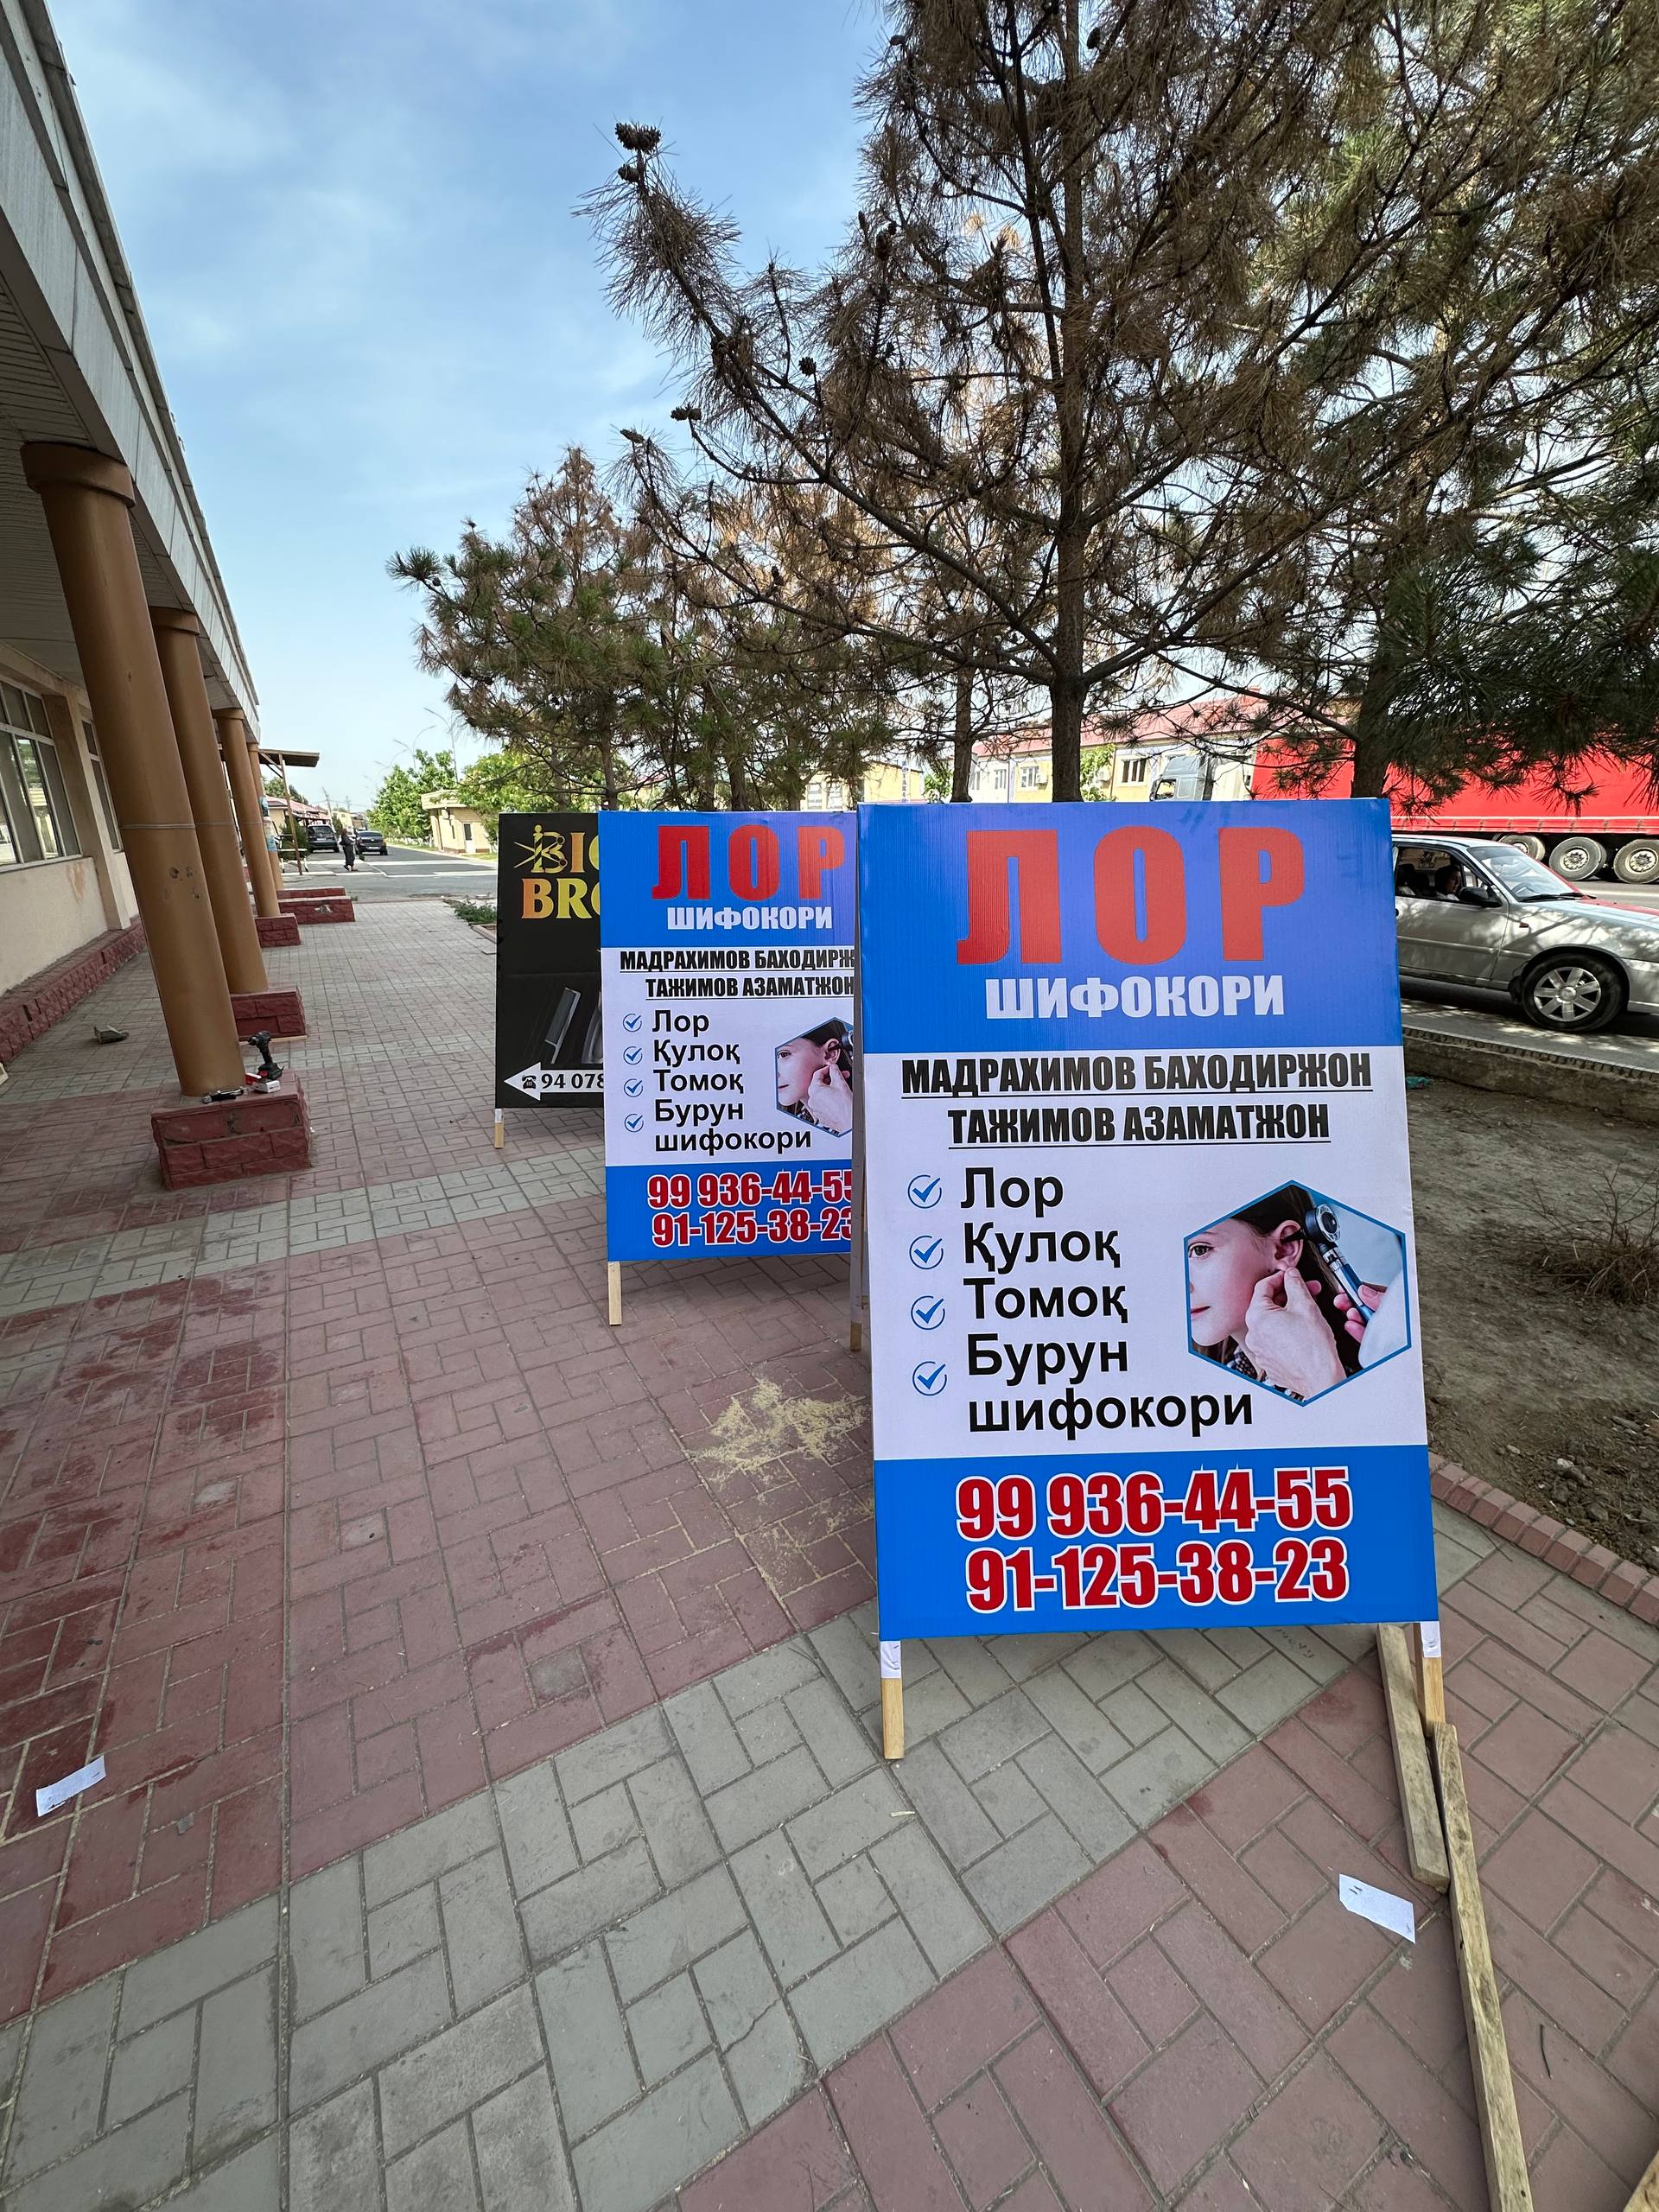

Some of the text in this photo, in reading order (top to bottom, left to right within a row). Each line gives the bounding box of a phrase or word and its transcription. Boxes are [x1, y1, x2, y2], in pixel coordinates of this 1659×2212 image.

[531, 824, 600, 874] BI
[652, 824, 845, 901] ЛОР
[521, 878, 601, 919] BR
[957, 825, 1305, 965] ЛОР
[666, 906, 833, 931] ШИФОКОРИ
[620, 950, 750, 972] МАДРАХИМОВ
[645, 976, 855, 998] ТАЖИМОВ АЗАМАТЖОН
[985, 975, 1284, 1020] ШИФОКОРИ
[652, 1009, 709, 1036] Лор
[653, 1039, 741, 1067] Қулоқ
[901, 1052, 1372, 1097] МАДРАХИМОВ БАХОДИРЖОН
[541, 1073, 604, 1089] 94 078
[653, 1069, 744, 1093] Томоқ
[654, 1099, 744, 1126] Бурун
[948, 1103, 1329, 1145] ТАЖИМОВ АЗАМАТЖОН
[655, 1128, 811, 1156] шифокори
[647, 1174, 692, 1209] 99
[961, 1167, 1064, 1217] Лор
[963, 1222, 1120, 1274] Қулоқ
[963, 1277, 1128, 1323] Томоқ
[967, 1333, 1128, 1385] Бурун
[969, 1388, 1253, 1440] шифокори
[956, 1465, 1354, 1542] 99 936-44-55
[965, 1536, 1348, 1614] 91-125-38-23
